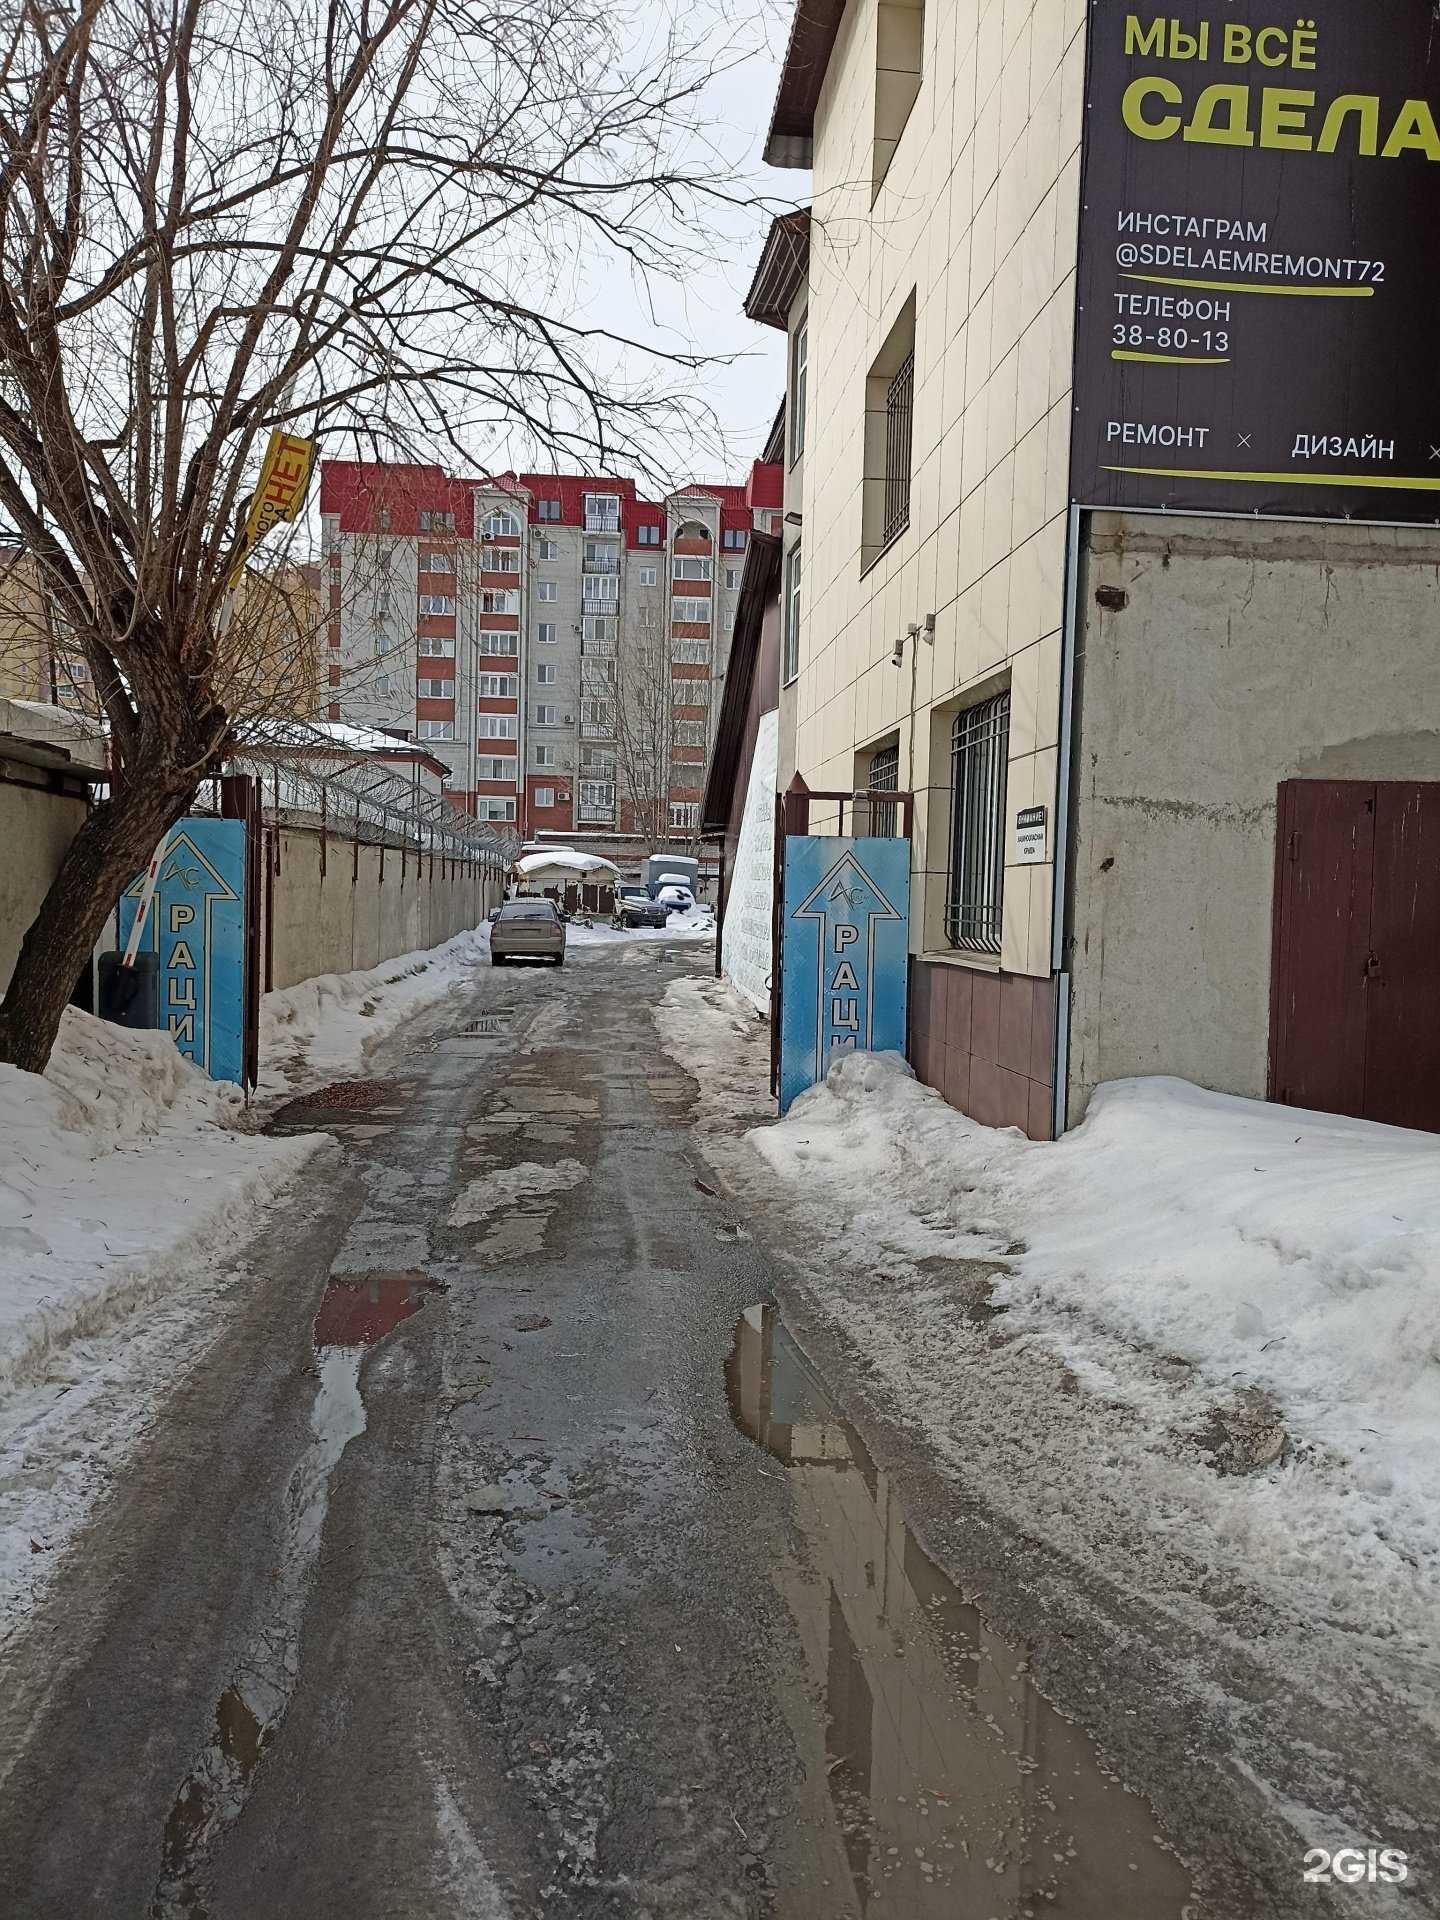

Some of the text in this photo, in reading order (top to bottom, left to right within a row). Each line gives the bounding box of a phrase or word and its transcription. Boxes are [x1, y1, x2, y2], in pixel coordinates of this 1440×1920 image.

[1124, 15, 1318, 70] МЫ ВСЁ
[1121, 76, 1440, 161] СДЕЛА
[1116, 211, 1267, 243] ИНСТАГРАМ
[1115, 243, 1386, 282] @SDELAEMREMONT72
[1113, 293, 1231, 322] ТЕЛЕФОН
[1112, 324, 1229, 352] 38-80-13
[1106, 421, 1395, 461] РЕМОНТ ДИЗАЙН
[264, 436, 306, 505] НЕТ
[167, 904, 197, 1060] РАЦИ
